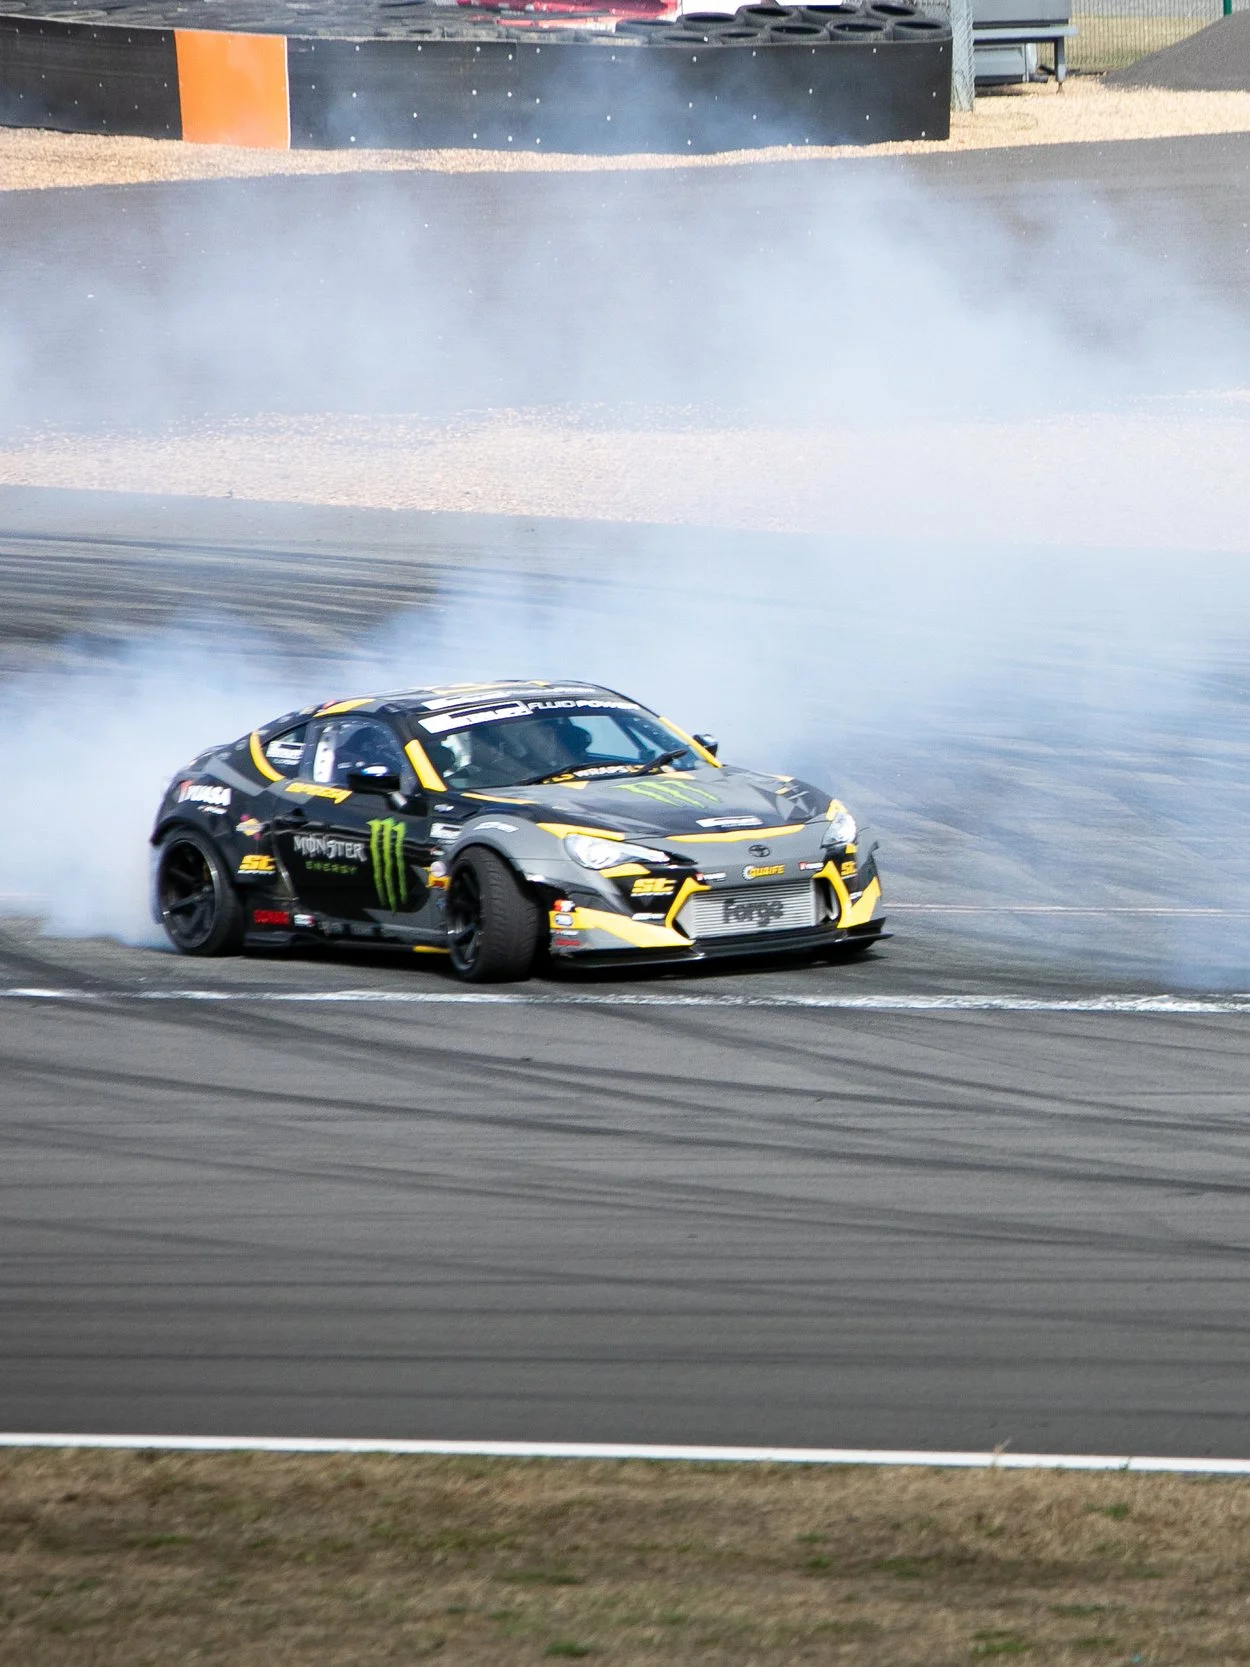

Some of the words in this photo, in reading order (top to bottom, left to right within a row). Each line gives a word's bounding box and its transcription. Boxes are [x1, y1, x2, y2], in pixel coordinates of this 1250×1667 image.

[528, 701, 576, 710] FLUID
[576, 700, 641, 711] POWER
[293, 834, 367, 863] MONSTER
[305, 861, 359, 875] ENERGY
[749, 864, 786, 878] QUAIFE
[723, 899, 784, 927] Forge
